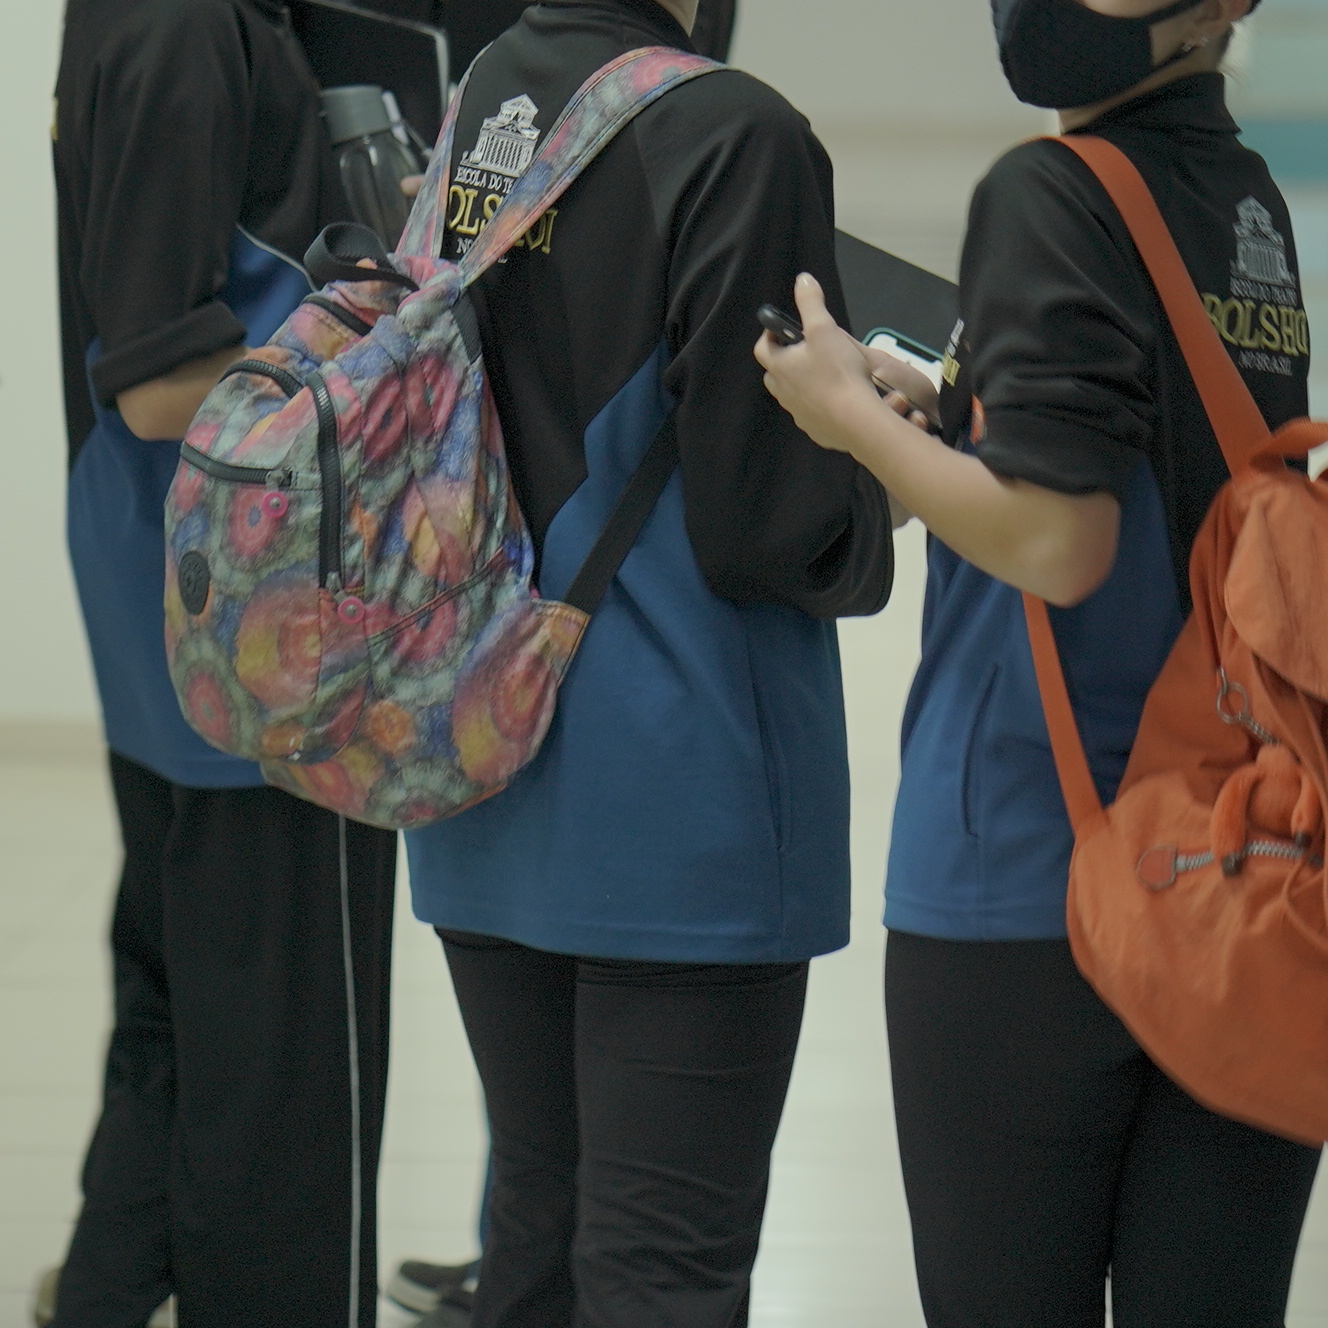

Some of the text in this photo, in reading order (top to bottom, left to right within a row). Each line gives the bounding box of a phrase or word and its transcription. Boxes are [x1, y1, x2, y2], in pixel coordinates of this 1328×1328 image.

[454, 165, 487, 188] ESCOLA
[487, 173, 502, 191] DO
[1200, 292, 1309, 356] BOLSHO
